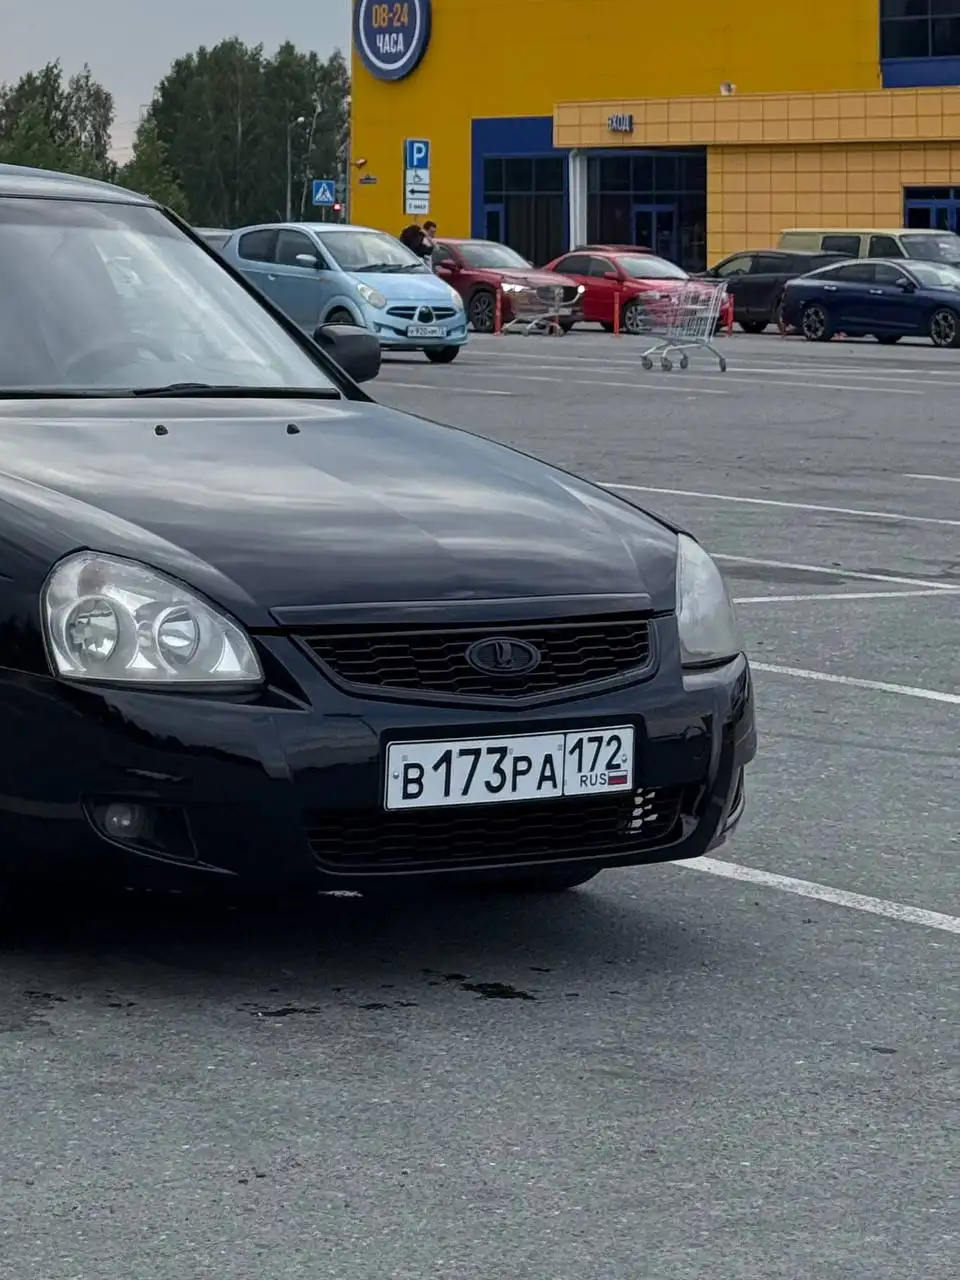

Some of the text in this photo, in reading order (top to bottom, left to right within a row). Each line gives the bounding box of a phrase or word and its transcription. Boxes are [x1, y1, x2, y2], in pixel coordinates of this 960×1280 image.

[372, 3, 409, 28] 08-24
[376, 32, 404, 54] ЧАСА
[413, 142, 426, 166] P
[401, 734, 622, 800] В173РА 172
[579, 773, 608, 788] RUS
